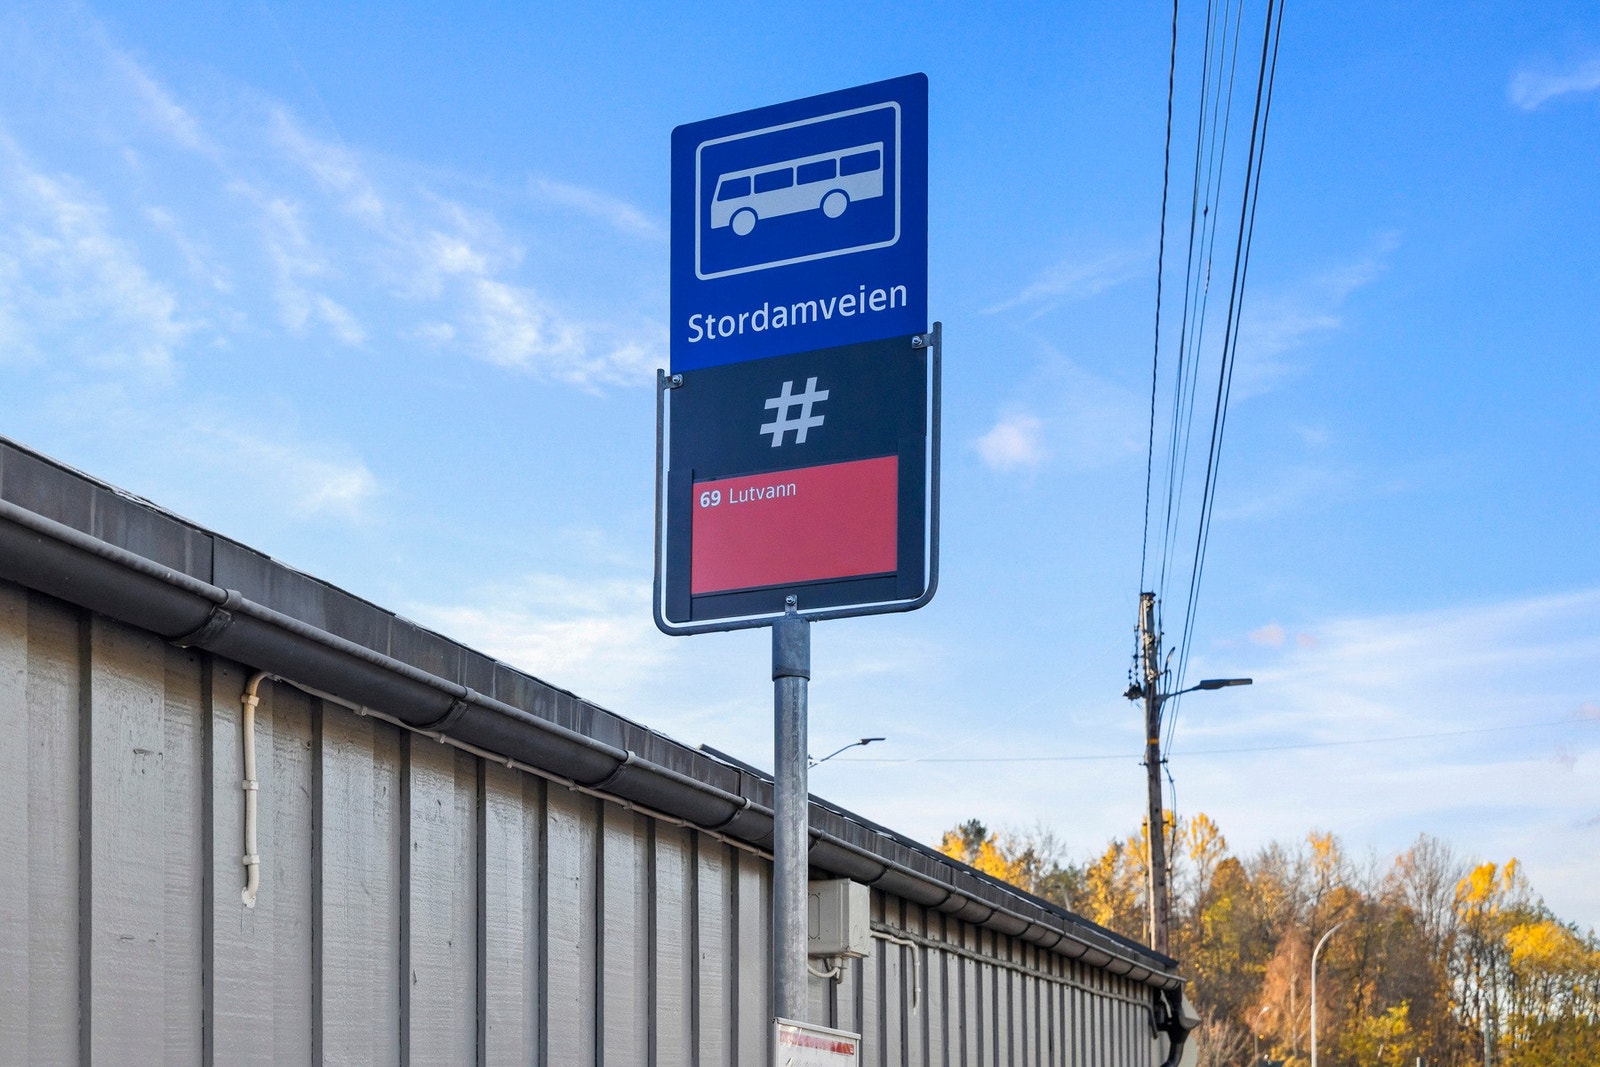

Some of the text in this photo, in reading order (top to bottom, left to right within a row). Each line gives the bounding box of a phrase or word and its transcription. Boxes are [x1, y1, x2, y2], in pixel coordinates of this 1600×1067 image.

[688, 284, 907, 343] Stordamveien
[700, 483, 796, 508] 69 Lutvann
